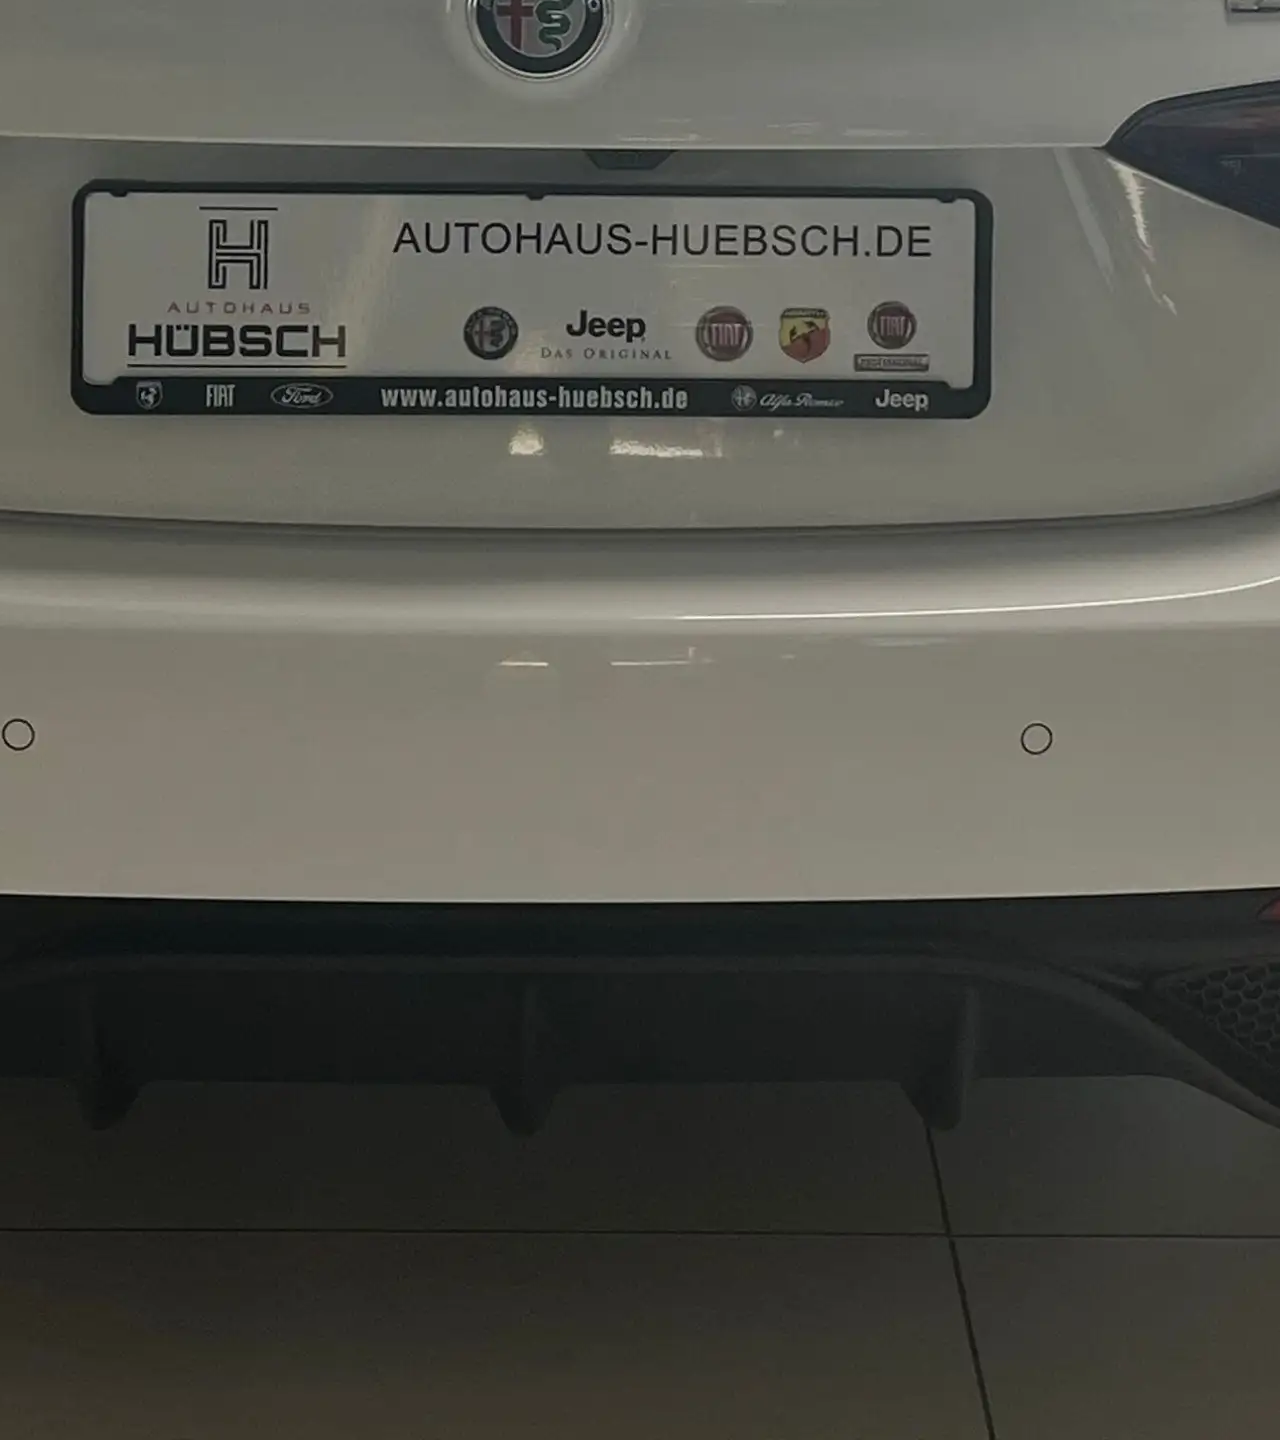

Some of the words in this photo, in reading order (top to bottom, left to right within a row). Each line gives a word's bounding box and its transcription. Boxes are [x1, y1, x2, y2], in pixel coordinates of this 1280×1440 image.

[392, 222, 932, 258] AUTOHAUS-HUEBSCH.DE
[167, 301, 311, 314] AUTOHAUS
[566, 309, 646, 343] Jeep
[127, 323, 347, 358] HÜBSCH
[206, 384, 236, 408] FIAT
[281, 386, 323, 405] Ford
[380, 386, 688, 410] www.autohaus-huebsch.de
[875, 388, 929, 410] Jeep
